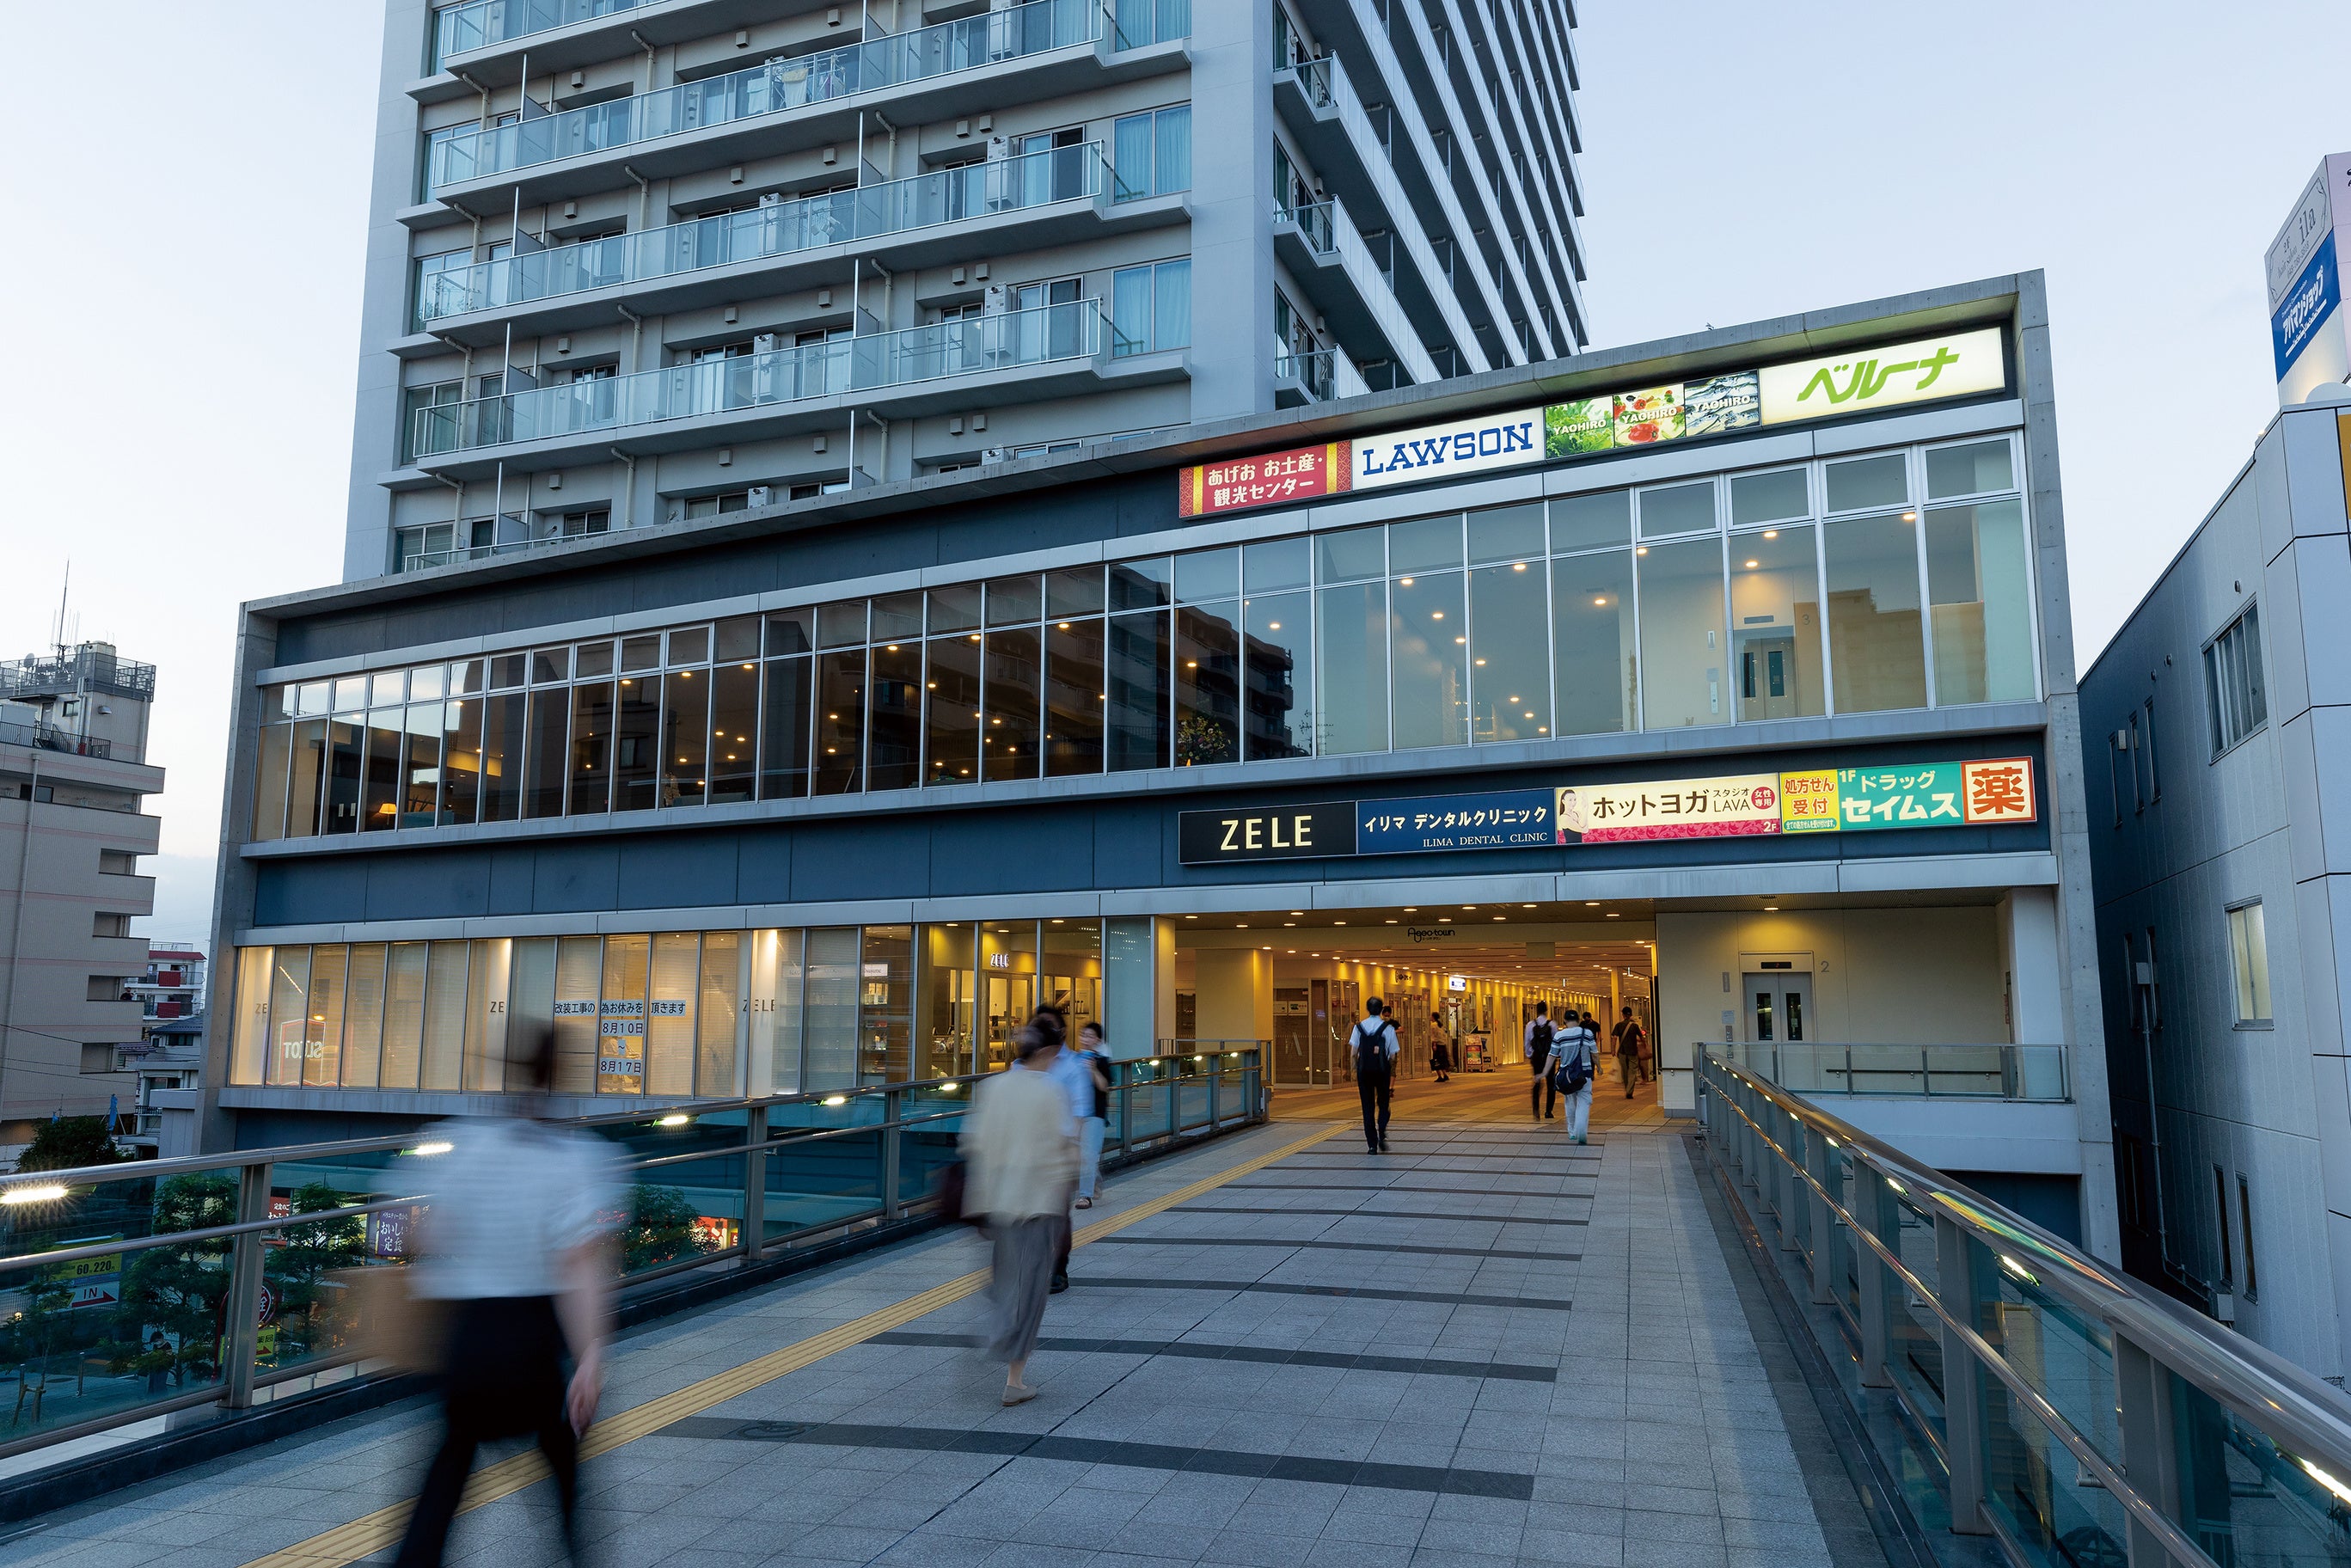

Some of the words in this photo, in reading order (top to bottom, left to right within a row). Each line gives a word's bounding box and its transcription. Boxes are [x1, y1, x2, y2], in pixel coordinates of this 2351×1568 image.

[2299, 208, 2316, 245] ila
[2282, 265, 2323, 345] アパマンショップ
[1797, 346, 1960, 404] ベルーナ
[1693, 395, 1751, 413] YAOHIRO
[1621, 407, 1677, 424] YAOHIRO
[1553, 419, 1607, 436] YAOHIRO
[1362, 422, 1534, 476] LAWSON
[1208, 463, 1256, 486] あげお
[1214, 478, 1314, 507] 観光センター
[1802, 614, 1810, 626] 3
[1839, 770, 1856, 783] 1F
[1861, 770, 1936, 793] ドラッグ
[1713, 787, 1750, 798] スタジオ
[1754, 789, 1772, 798] 女性
[1785, 777, 1834, 794] 処方せん
[1971, 767, 2025, 815] 薬
[1593, 788, 1710, 819] ホットヨガ
[1713, 799, 1750, 812] LAVA
[1754, 798, 1772, 806] 専用
[1793, 798, 1828, 815] 受付
[1841, 793, 1961, 823] セイムス
[1364, 815, 1406, 833] イリマ
[1414, 806, 1546, 830] デンタルクリニック
[1763, 821, 1777, 832] 2F
[1220, 815, 1313, 851] ZELE
[1423, 837, 1454, 847] ILIMA
[1460, 835, 1504, 845] DENTAL
[1509, 832, 1547, 842] CLINIC
[990, 953, 1009, 967] ZELE
[1821, 960, 1830, 972] 2
[554, 1002, 595, 1014] 改装工事の
[601, 1002, 643, 1014] 為お休みを
[651, 1002, 685, 1014] 頂きます
[743, 999, 775, 1012] ZELE
[603, 1023, 643, 1034] 8月10日
[600, 1061, 641, 1073] 8月17日
[83, 1287, 98, 1300] IN
